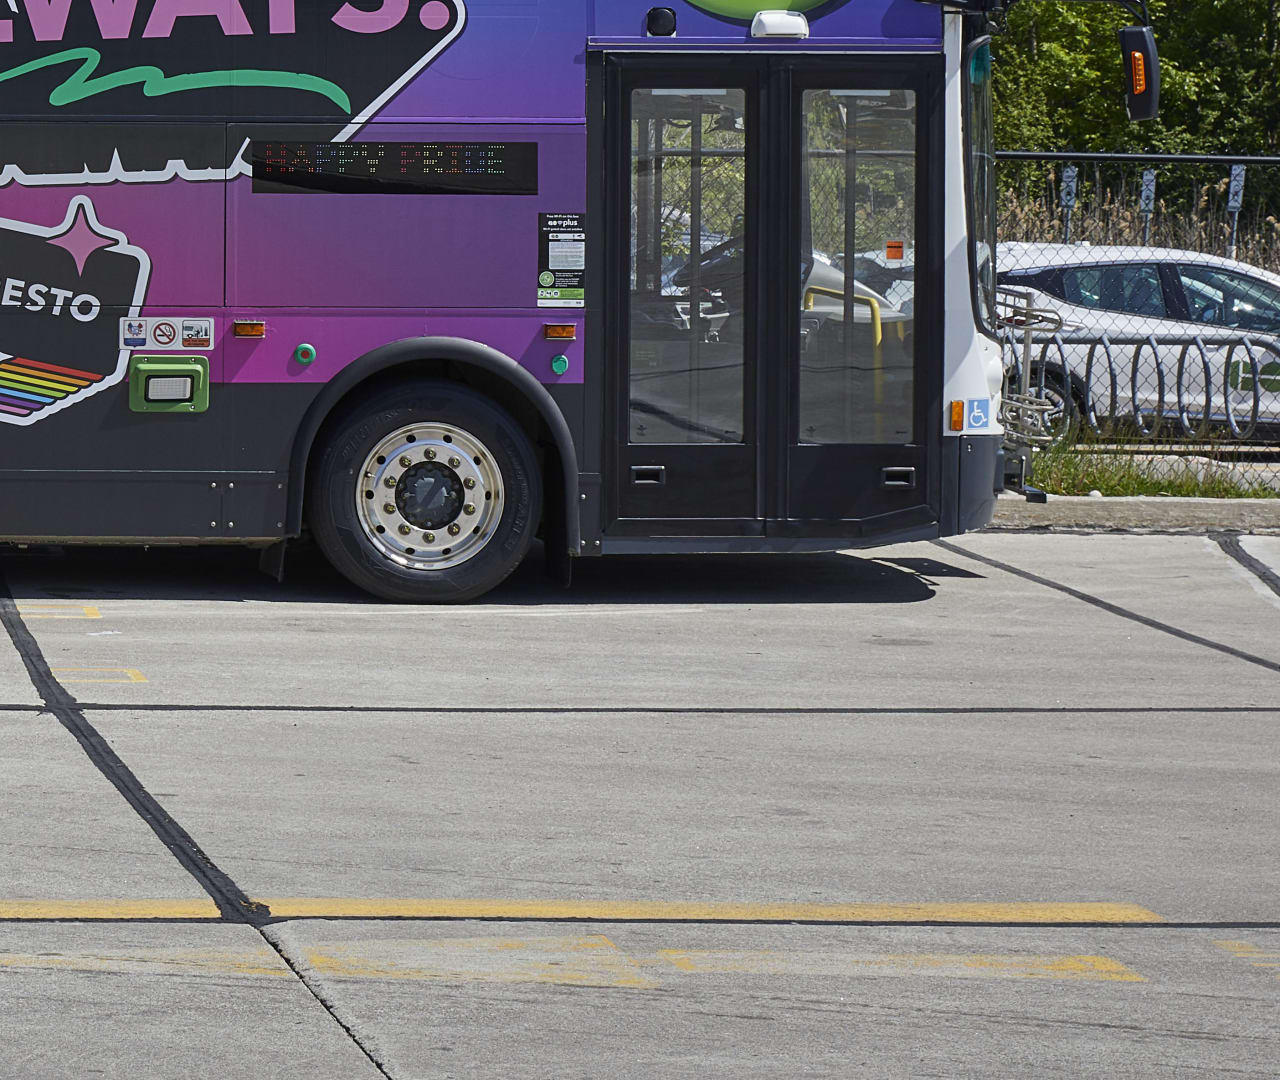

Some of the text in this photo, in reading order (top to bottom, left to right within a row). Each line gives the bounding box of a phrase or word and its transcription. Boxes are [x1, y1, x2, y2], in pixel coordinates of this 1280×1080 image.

[266, 144, 506, 174] HAPPY PRIDE
[562, 218, 578, 227] plus
